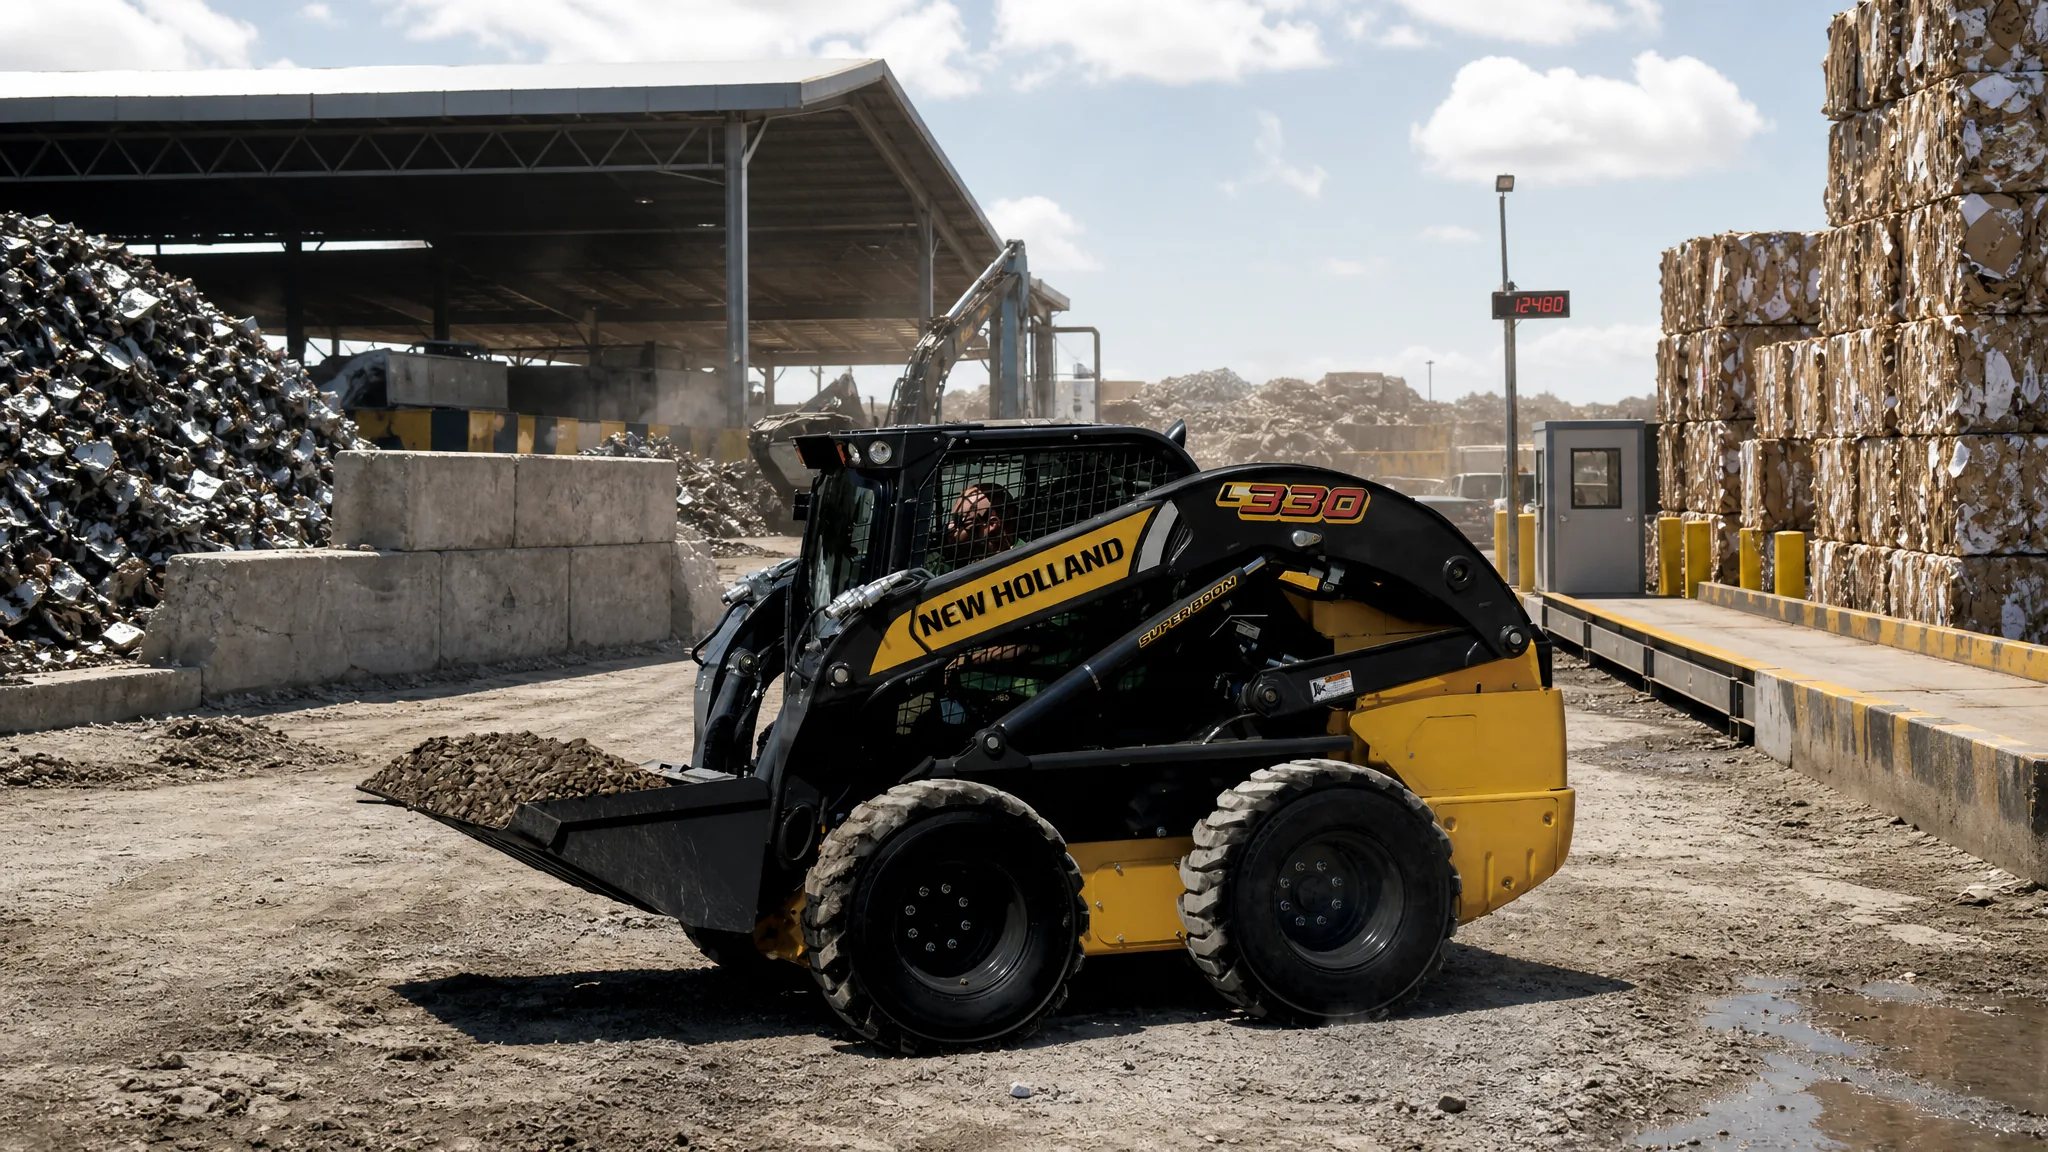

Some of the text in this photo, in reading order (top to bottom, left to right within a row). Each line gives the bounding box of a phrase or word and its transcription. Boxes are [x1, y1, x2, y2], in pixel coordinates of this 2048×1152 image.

[1515, 296, 1563, 313] 12480
[1216, 482, 1371, 524] L330
[918, 537, 1124, 637] NEW HOLLAND
